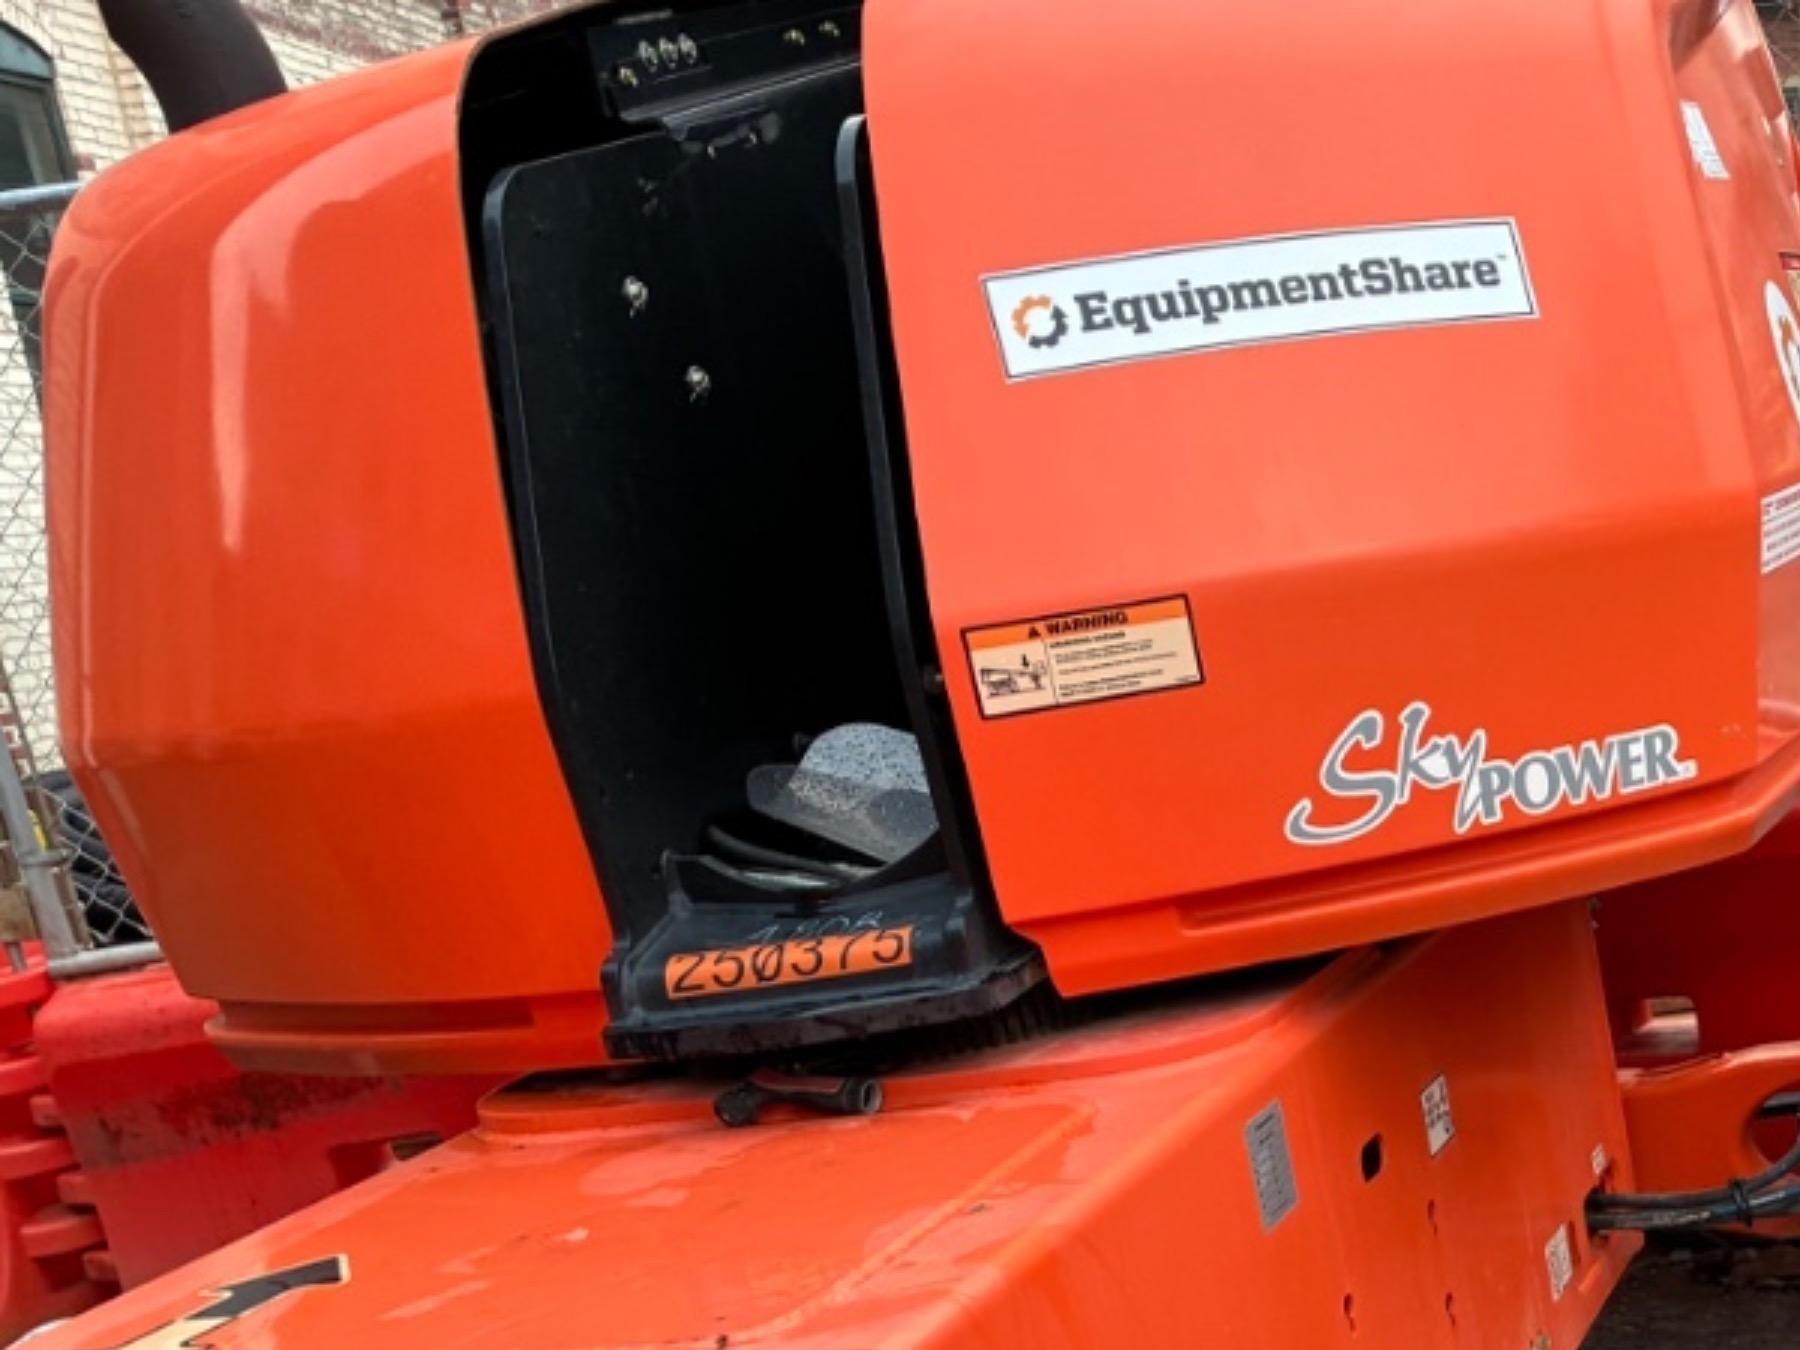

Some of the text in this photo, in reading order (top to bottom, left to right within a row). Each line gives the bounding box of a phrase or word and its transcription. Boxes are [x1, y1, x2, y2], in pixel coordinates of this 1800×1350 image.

[1073, 255, 1501, 334] EquipmentShare
[1046, 610, 1130, 634] WARNING
[671, 929, 905, 993] 250375
